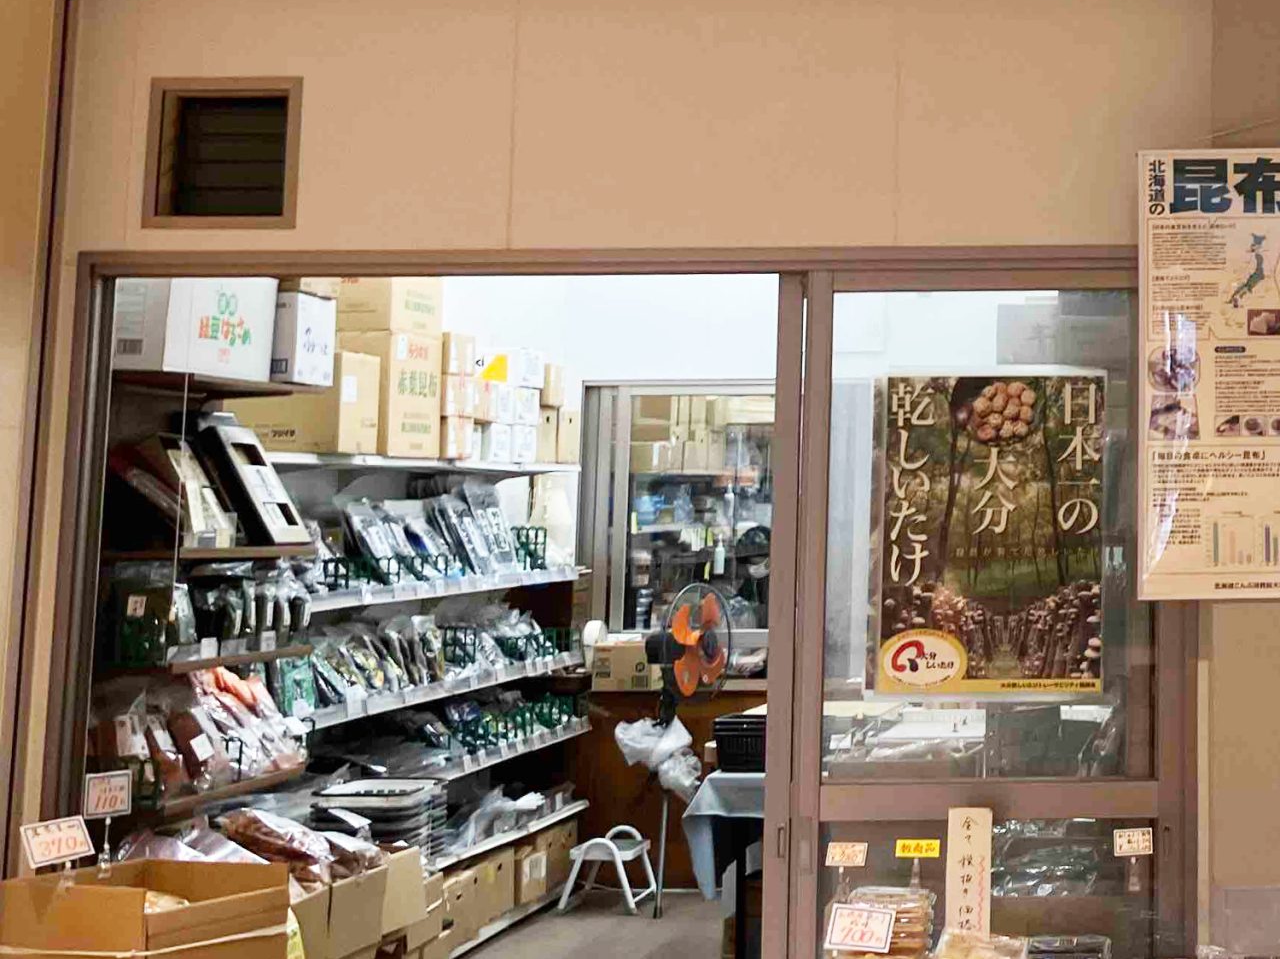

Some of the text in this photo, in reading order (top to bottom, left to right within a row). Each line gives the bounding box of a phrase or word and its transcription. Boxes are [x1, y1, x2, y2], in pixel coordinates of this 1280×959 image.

[1148, 160, 1166, 216] 北海道の
[890, 382, 936, 586] 乾しいたけ
[973, 447, 1018, 535] 大分
[1057, 382, 1100, 534] 日本一の
